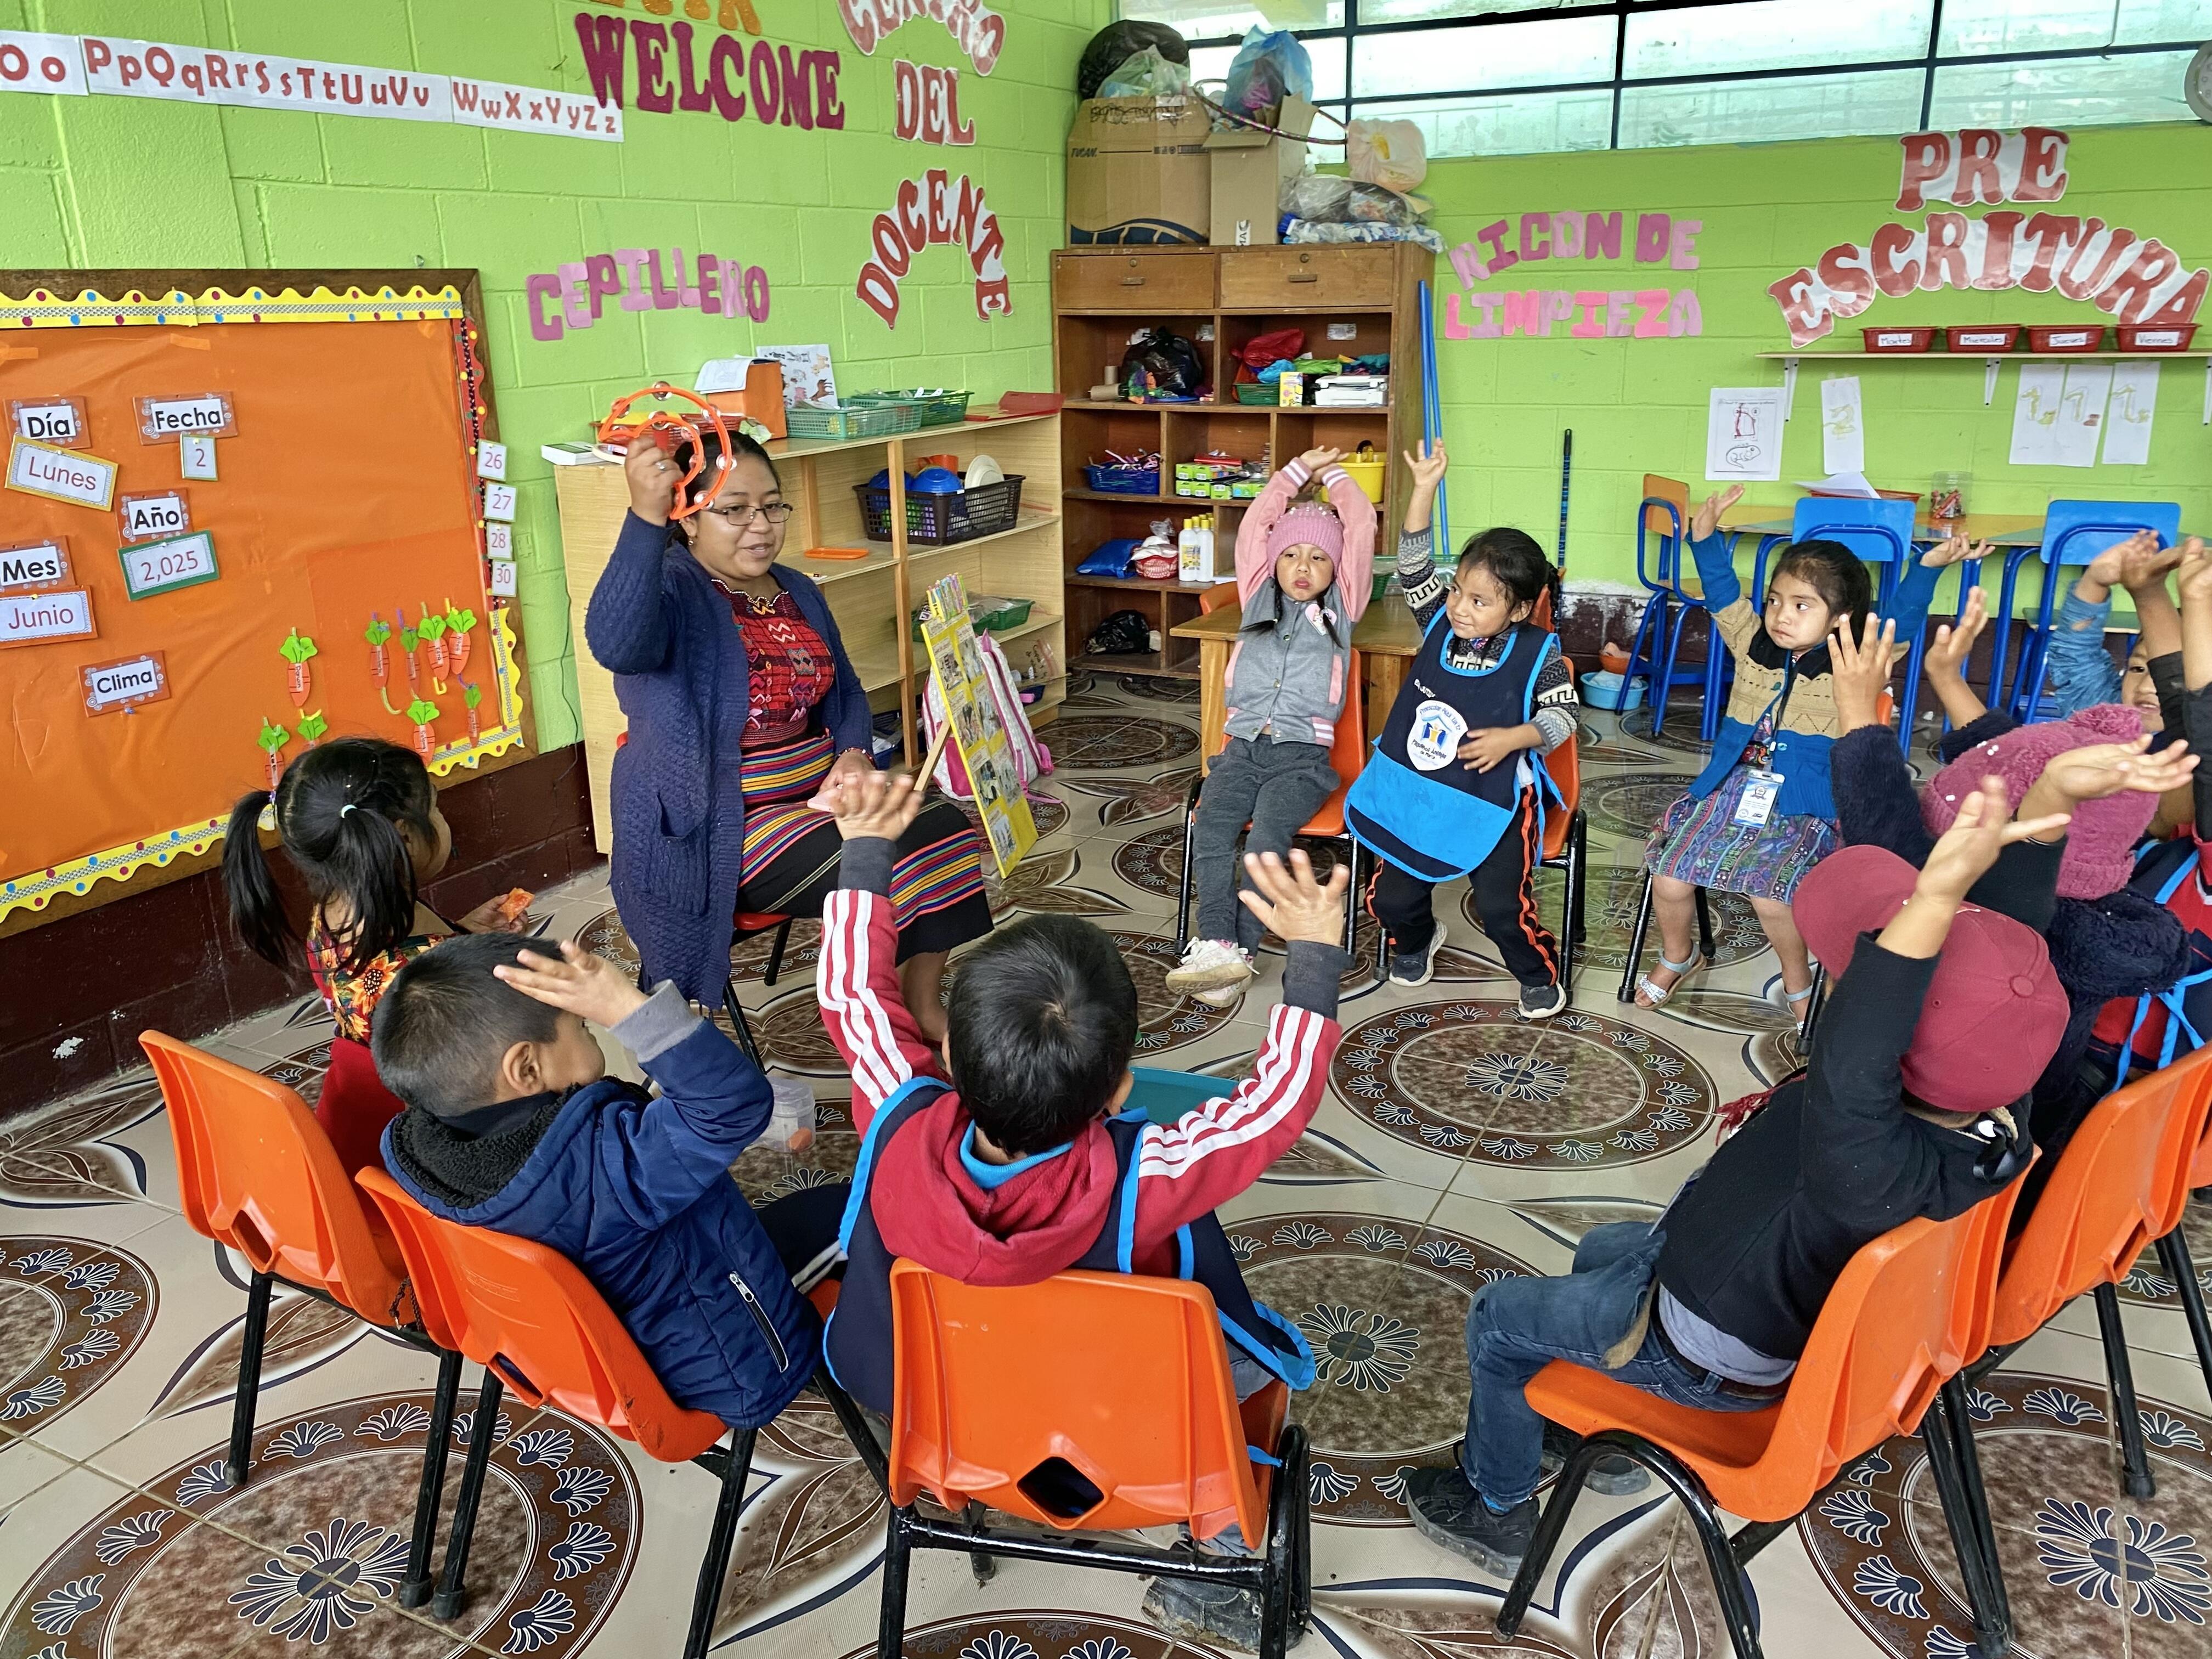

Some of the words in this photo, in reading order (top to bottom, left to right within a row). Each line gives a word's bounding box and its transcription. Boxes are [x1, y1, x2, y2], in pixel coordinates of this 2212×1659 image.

[574, 13, 844, 130] WELCOME
[895, 60, 975, 144] DEL
[1896, 127, 2069, 211] PRE
[857, 169, 1013, 329] DOCENTE
[1449, 211, 1622, 291] RICON
[1635, 213, 1702, 270] DE
[1768, 211, 2211, 348] ESCRITURA
[527, 247, 769, 340] CEPILLERO
[1445, 289, 1702, 340] LIMPIEZA
[27, 413, 70, 437] Día
[155, 408, 221, 430] Fecha
[195, 448, 206, 467] 2
[484, 452, 503, 470] 26
[29, 456, 97, 490] Lunes
[493, 493, 511, 511] 27
[134, 506, 179, 530] Año
[491, 532, 506, 549] 28
[3, 558, 57, 583] Mes
[141, 550, 199, 583] 2,025
[495, 567, 511, 584] 30
[8, 604, 74, 630] Junio
[97, 671, 153, 694] Clima
